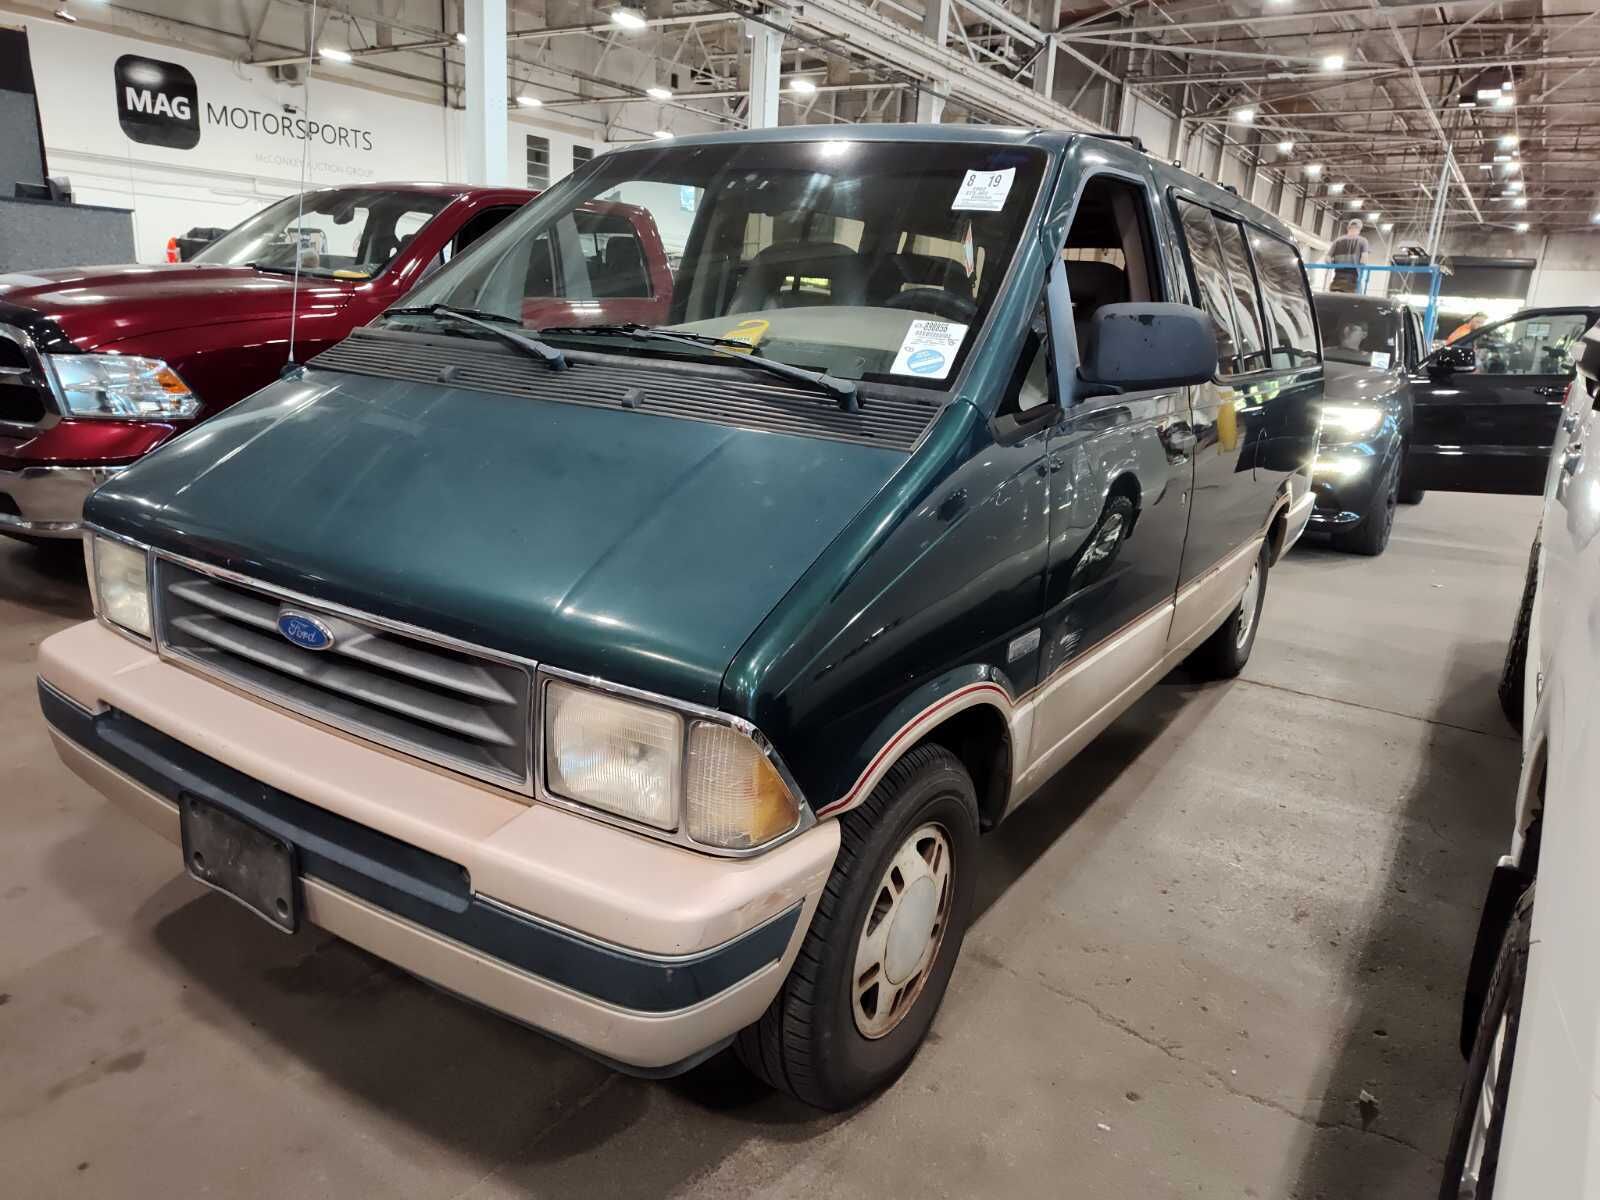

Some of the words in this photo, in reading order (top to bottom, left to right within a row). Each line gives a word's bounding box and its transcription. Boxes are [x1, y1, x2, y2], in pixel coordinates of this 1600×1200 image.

[125, 87, 191, 120] MAG
[206, 102, 373, 151] MOTORSPORTS
[966, 174, 977, 187] 8
[987, 174, 1002, 188] 19
[288, 620, 318, 643] Ford
